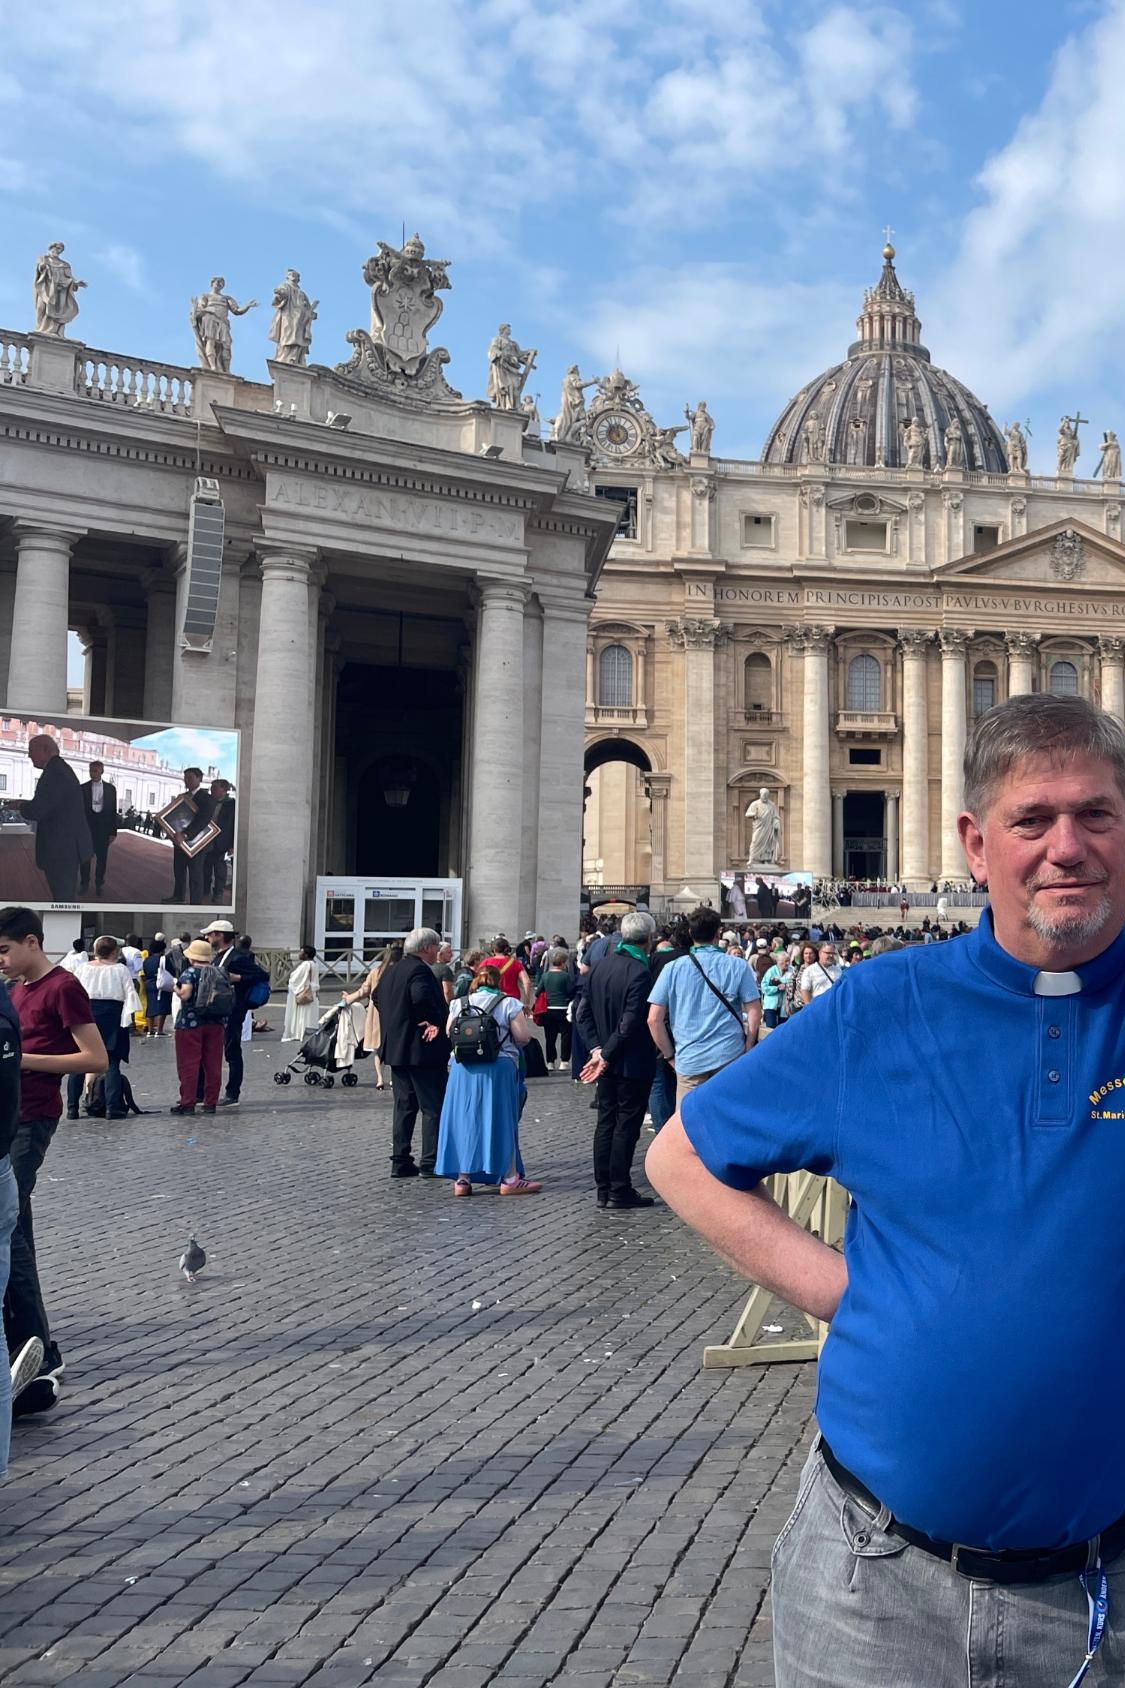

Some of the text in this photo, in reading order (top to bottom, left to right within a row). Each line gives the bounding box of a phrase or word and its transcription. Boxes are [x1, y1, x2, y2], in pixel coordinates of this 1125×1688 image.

[687, 584, 707, 597] IN
[713, 587, 799, 603] HONOREM
[1013, 600, 1108, 615] BVRGHESIVS
